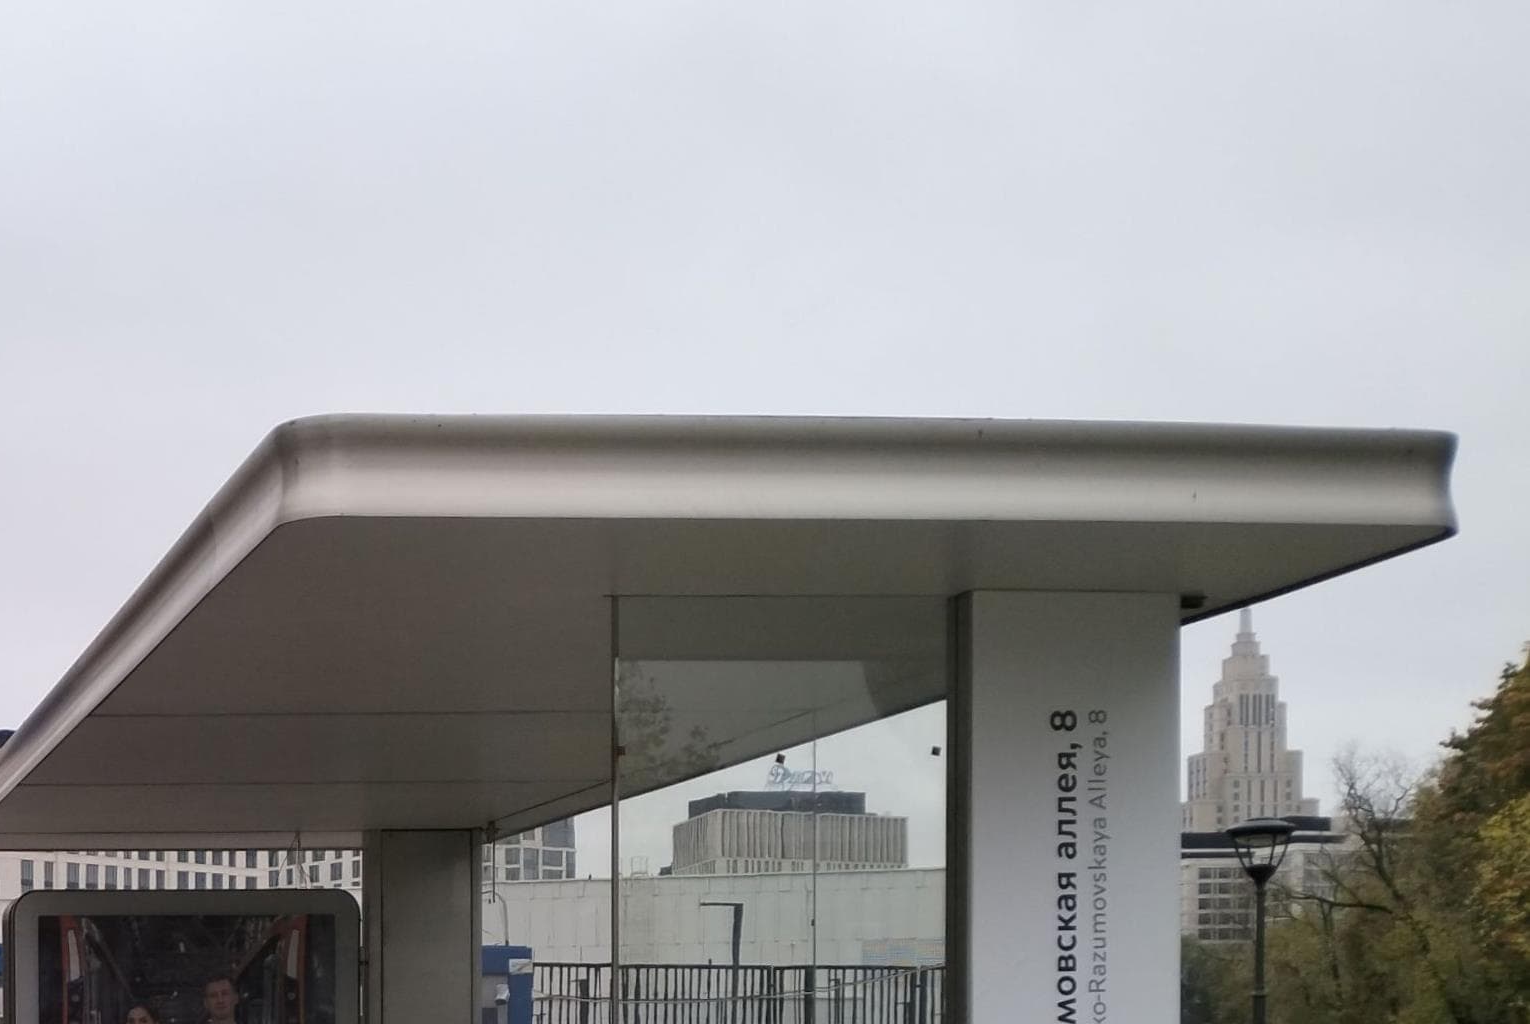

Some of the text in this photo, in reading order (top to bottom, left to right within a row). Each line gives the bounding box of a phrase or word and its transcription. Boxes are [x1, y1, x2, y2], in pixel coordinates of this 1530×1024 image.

[1049, 709, 1078, 732] 8
[1088, 709, 1107, 725] 8
[1087, 730, 1111, 811] Alleya,
[1057, 742, 1083, 860] аллея,
